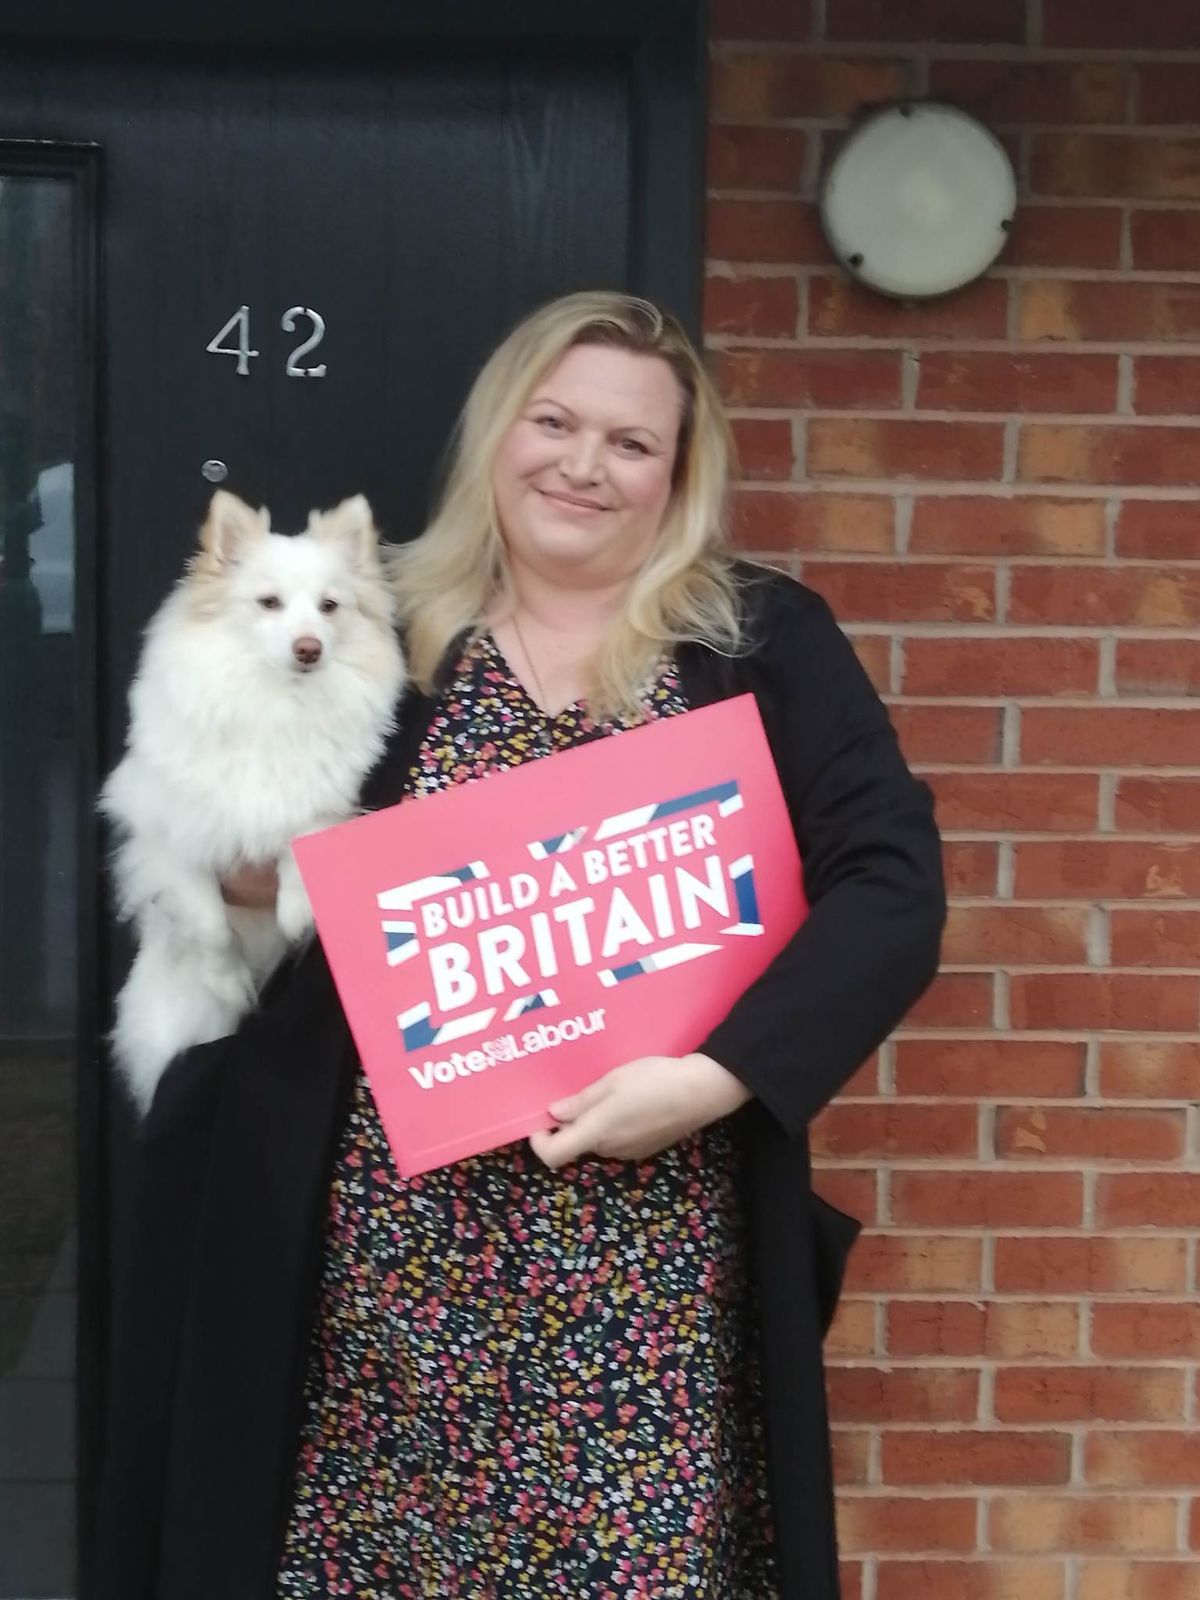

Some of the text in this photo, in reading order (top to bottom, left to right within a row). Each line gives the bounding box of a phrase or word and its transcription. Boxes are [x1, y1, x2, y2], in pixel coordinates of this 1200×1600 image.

[206, 305, 327, 377] 42
[421, 814, 717, 938] BUILD A BETTER
[428, 855, 730, 1012] BRITAIN
[408, 1008, 606, 1089] Vote Labour
